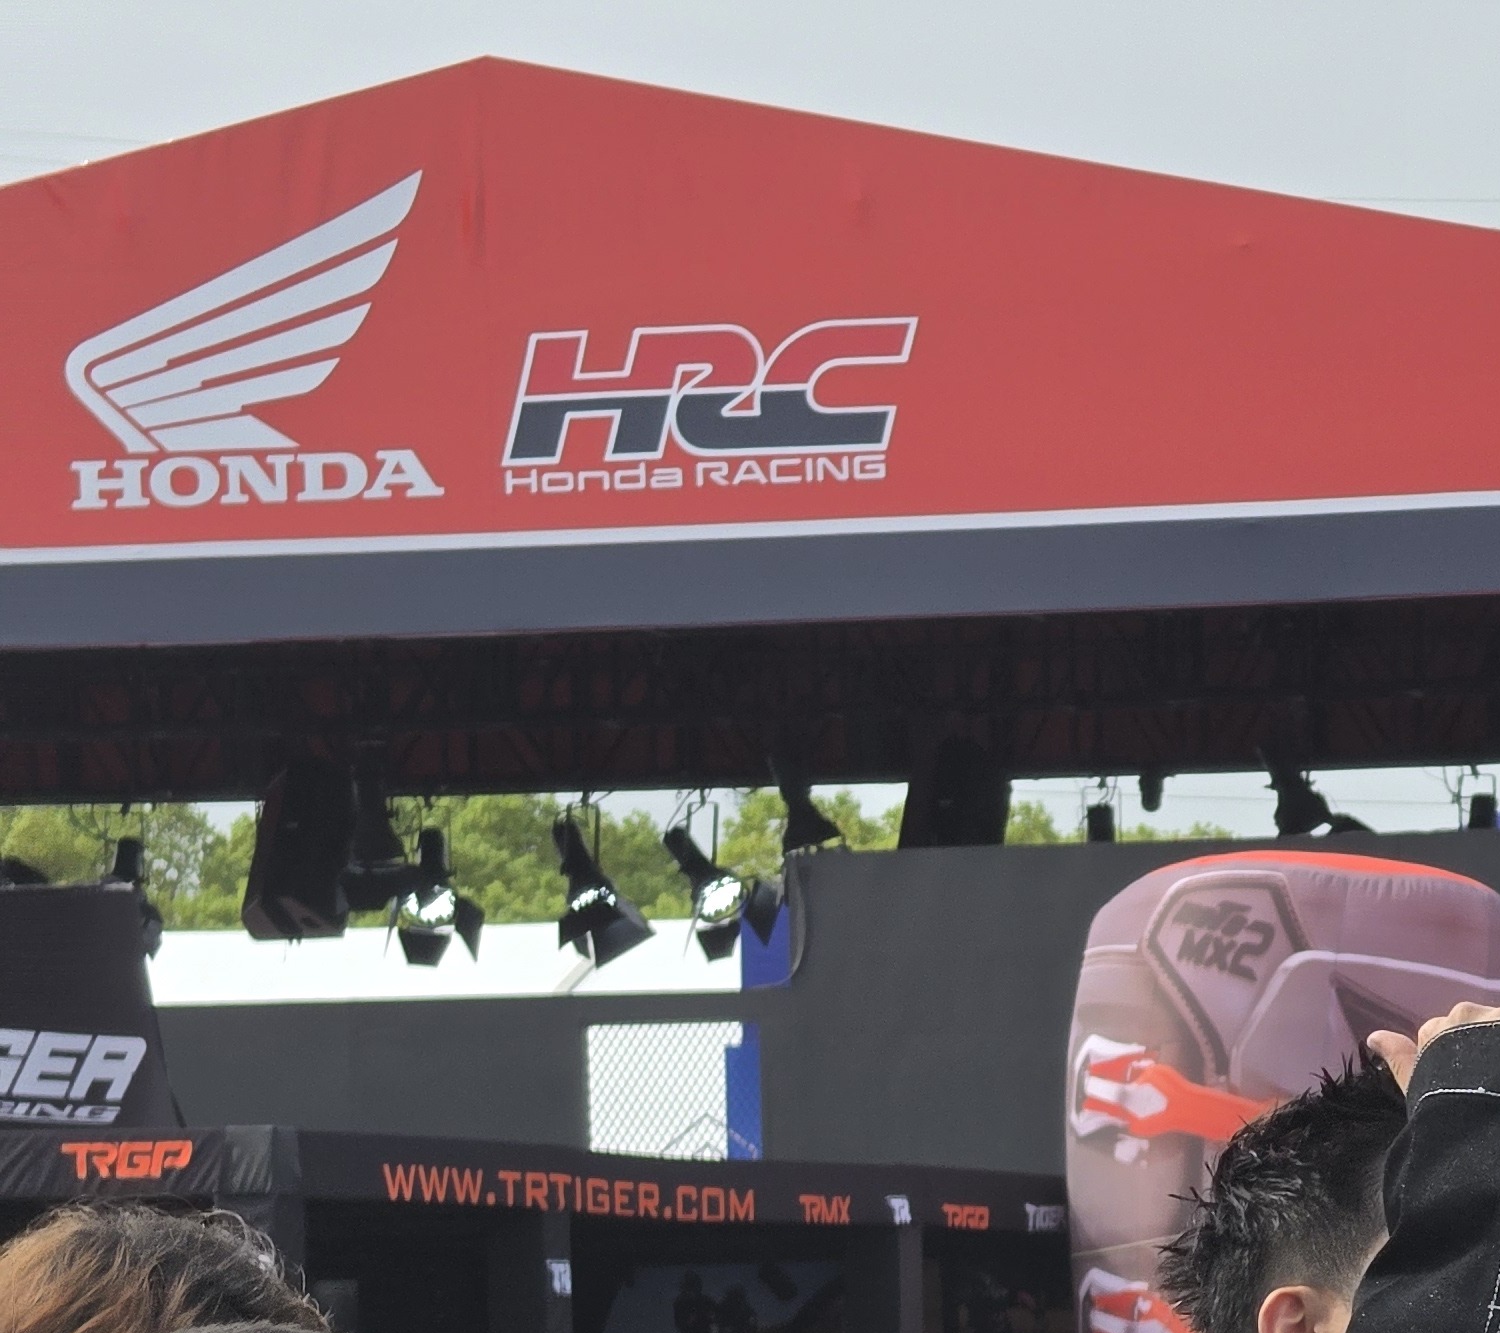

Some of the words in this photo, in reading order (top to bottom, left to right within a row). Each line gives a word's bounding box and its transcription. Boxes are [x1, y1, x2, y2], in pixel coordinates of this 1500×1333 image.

[501, 316, 918, 467] HRC
[71, 449, 445, 510] HONDA
[505, 460, 682, 494] Honda
[695, 453, 887, 487] RACING
[61, 1140, 193, 1179] TRGP
[383, 1163, 755, 1222] WWW.TRTIGER.COM
